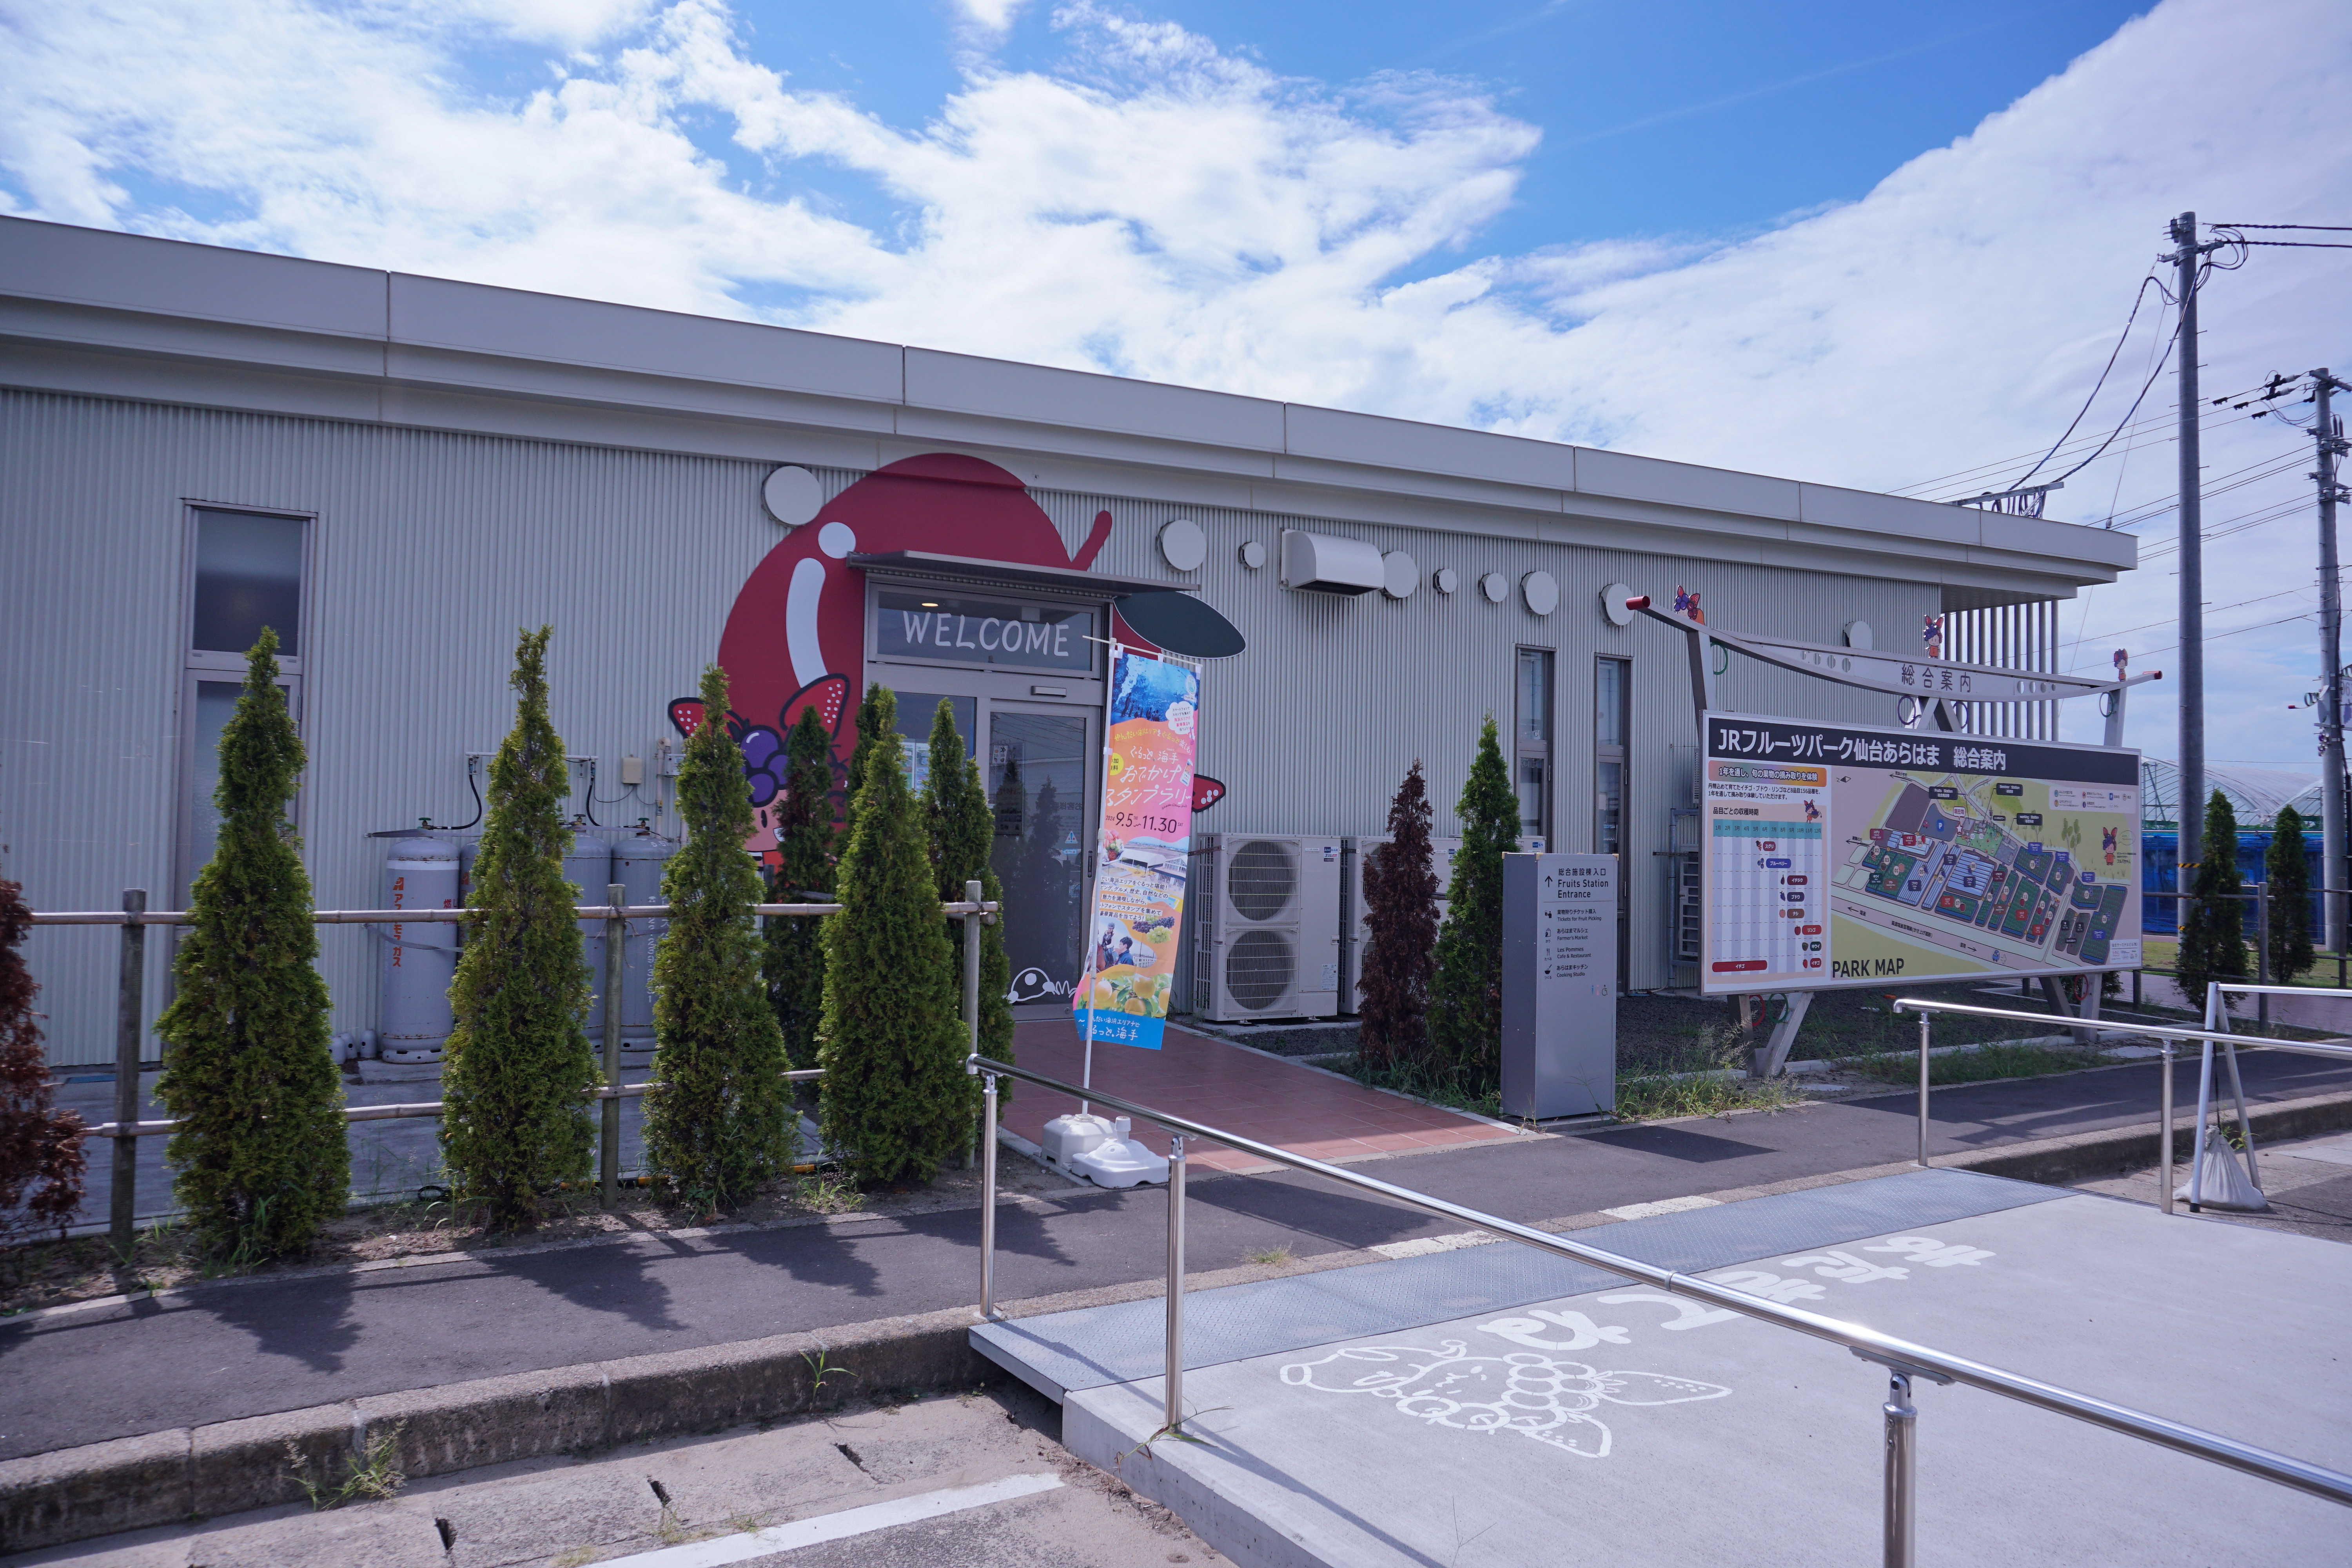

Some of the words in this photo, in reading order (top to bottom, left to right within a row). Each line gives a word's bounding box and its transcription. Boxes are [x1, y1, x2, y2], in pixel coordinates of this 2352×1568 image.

[903, 610, 1069, 656] WELCOME
[1901, 663, 1971, 693] 総合案内
[1718, 729, 1940, 766] JRフルーツパーク仙台あらはま
[1953, 746, 2006, 771] 総合案内
[1120, 764, 1182, 783] おでかけ
[1719, 767, 1818, 782] 1年を通し、旬の果物の摘み取りを体験
[1713, 807, 1759, 816] 品目ごとの収穫時期
[1115, 812, 1133, 827] 9.5
[1143, 815, 1177, 833] 11.30
[1558, 868, 1606, 876] 総合施設棟入口
[1558, 879, 1580, 887] Fruits
[393, 893, 403, 967] アスモスガス
[1833, 960, 1871, 978] PARK
[1875, 958, 1904, 976] MAP
